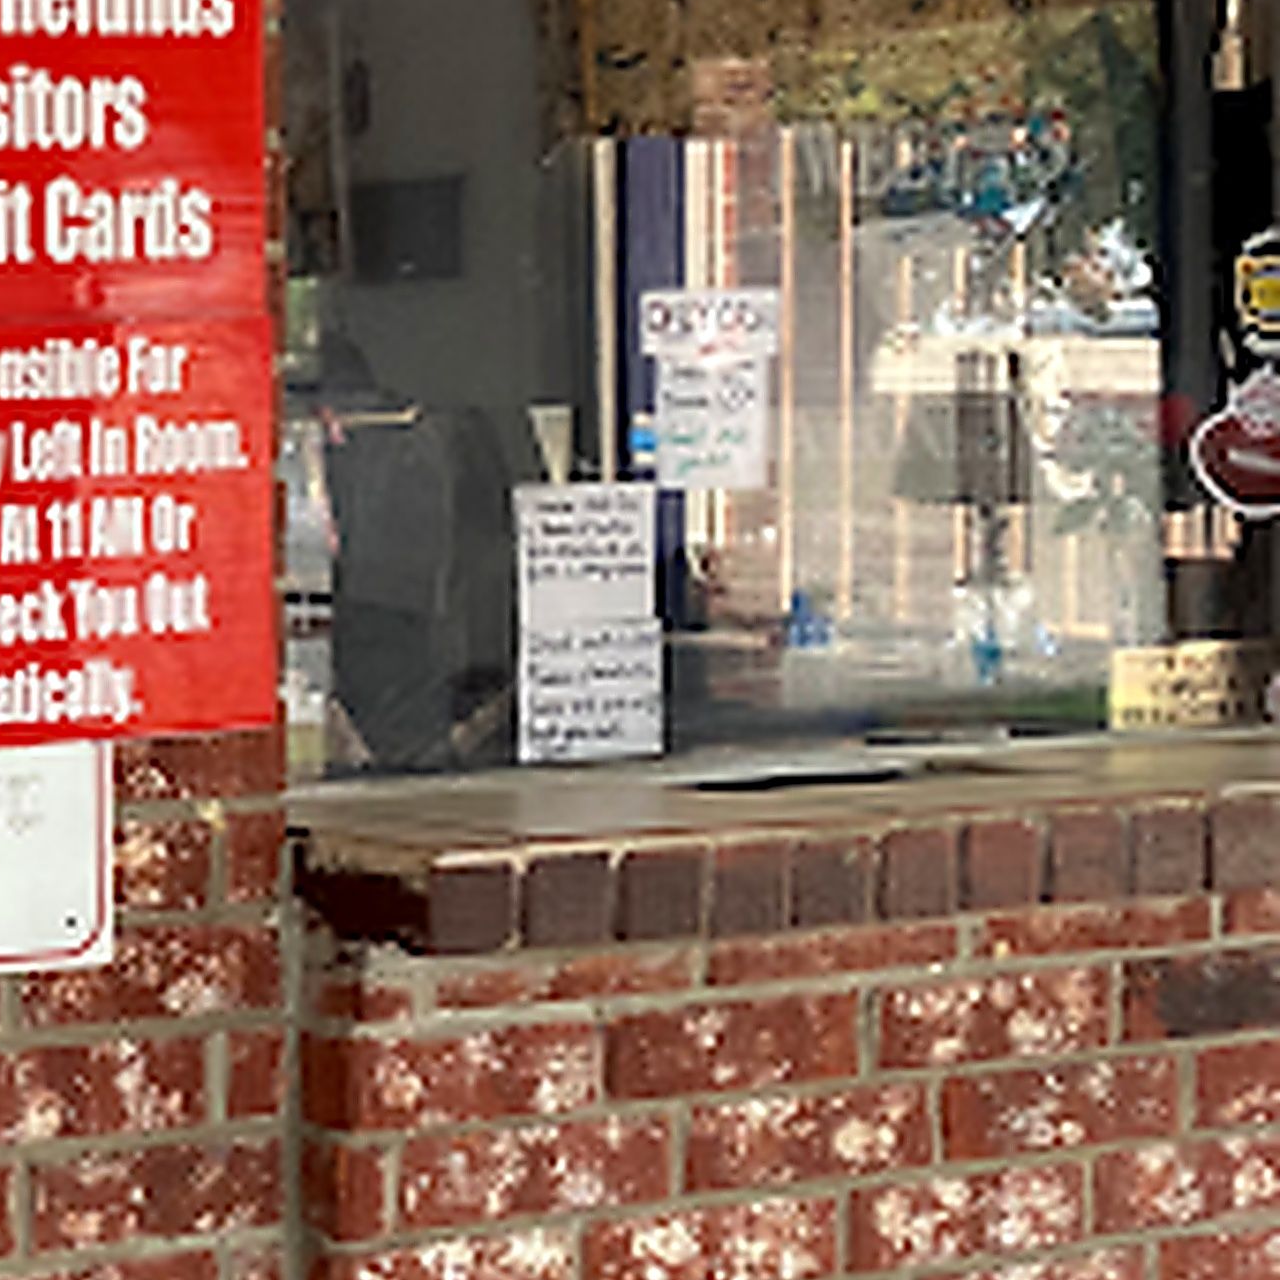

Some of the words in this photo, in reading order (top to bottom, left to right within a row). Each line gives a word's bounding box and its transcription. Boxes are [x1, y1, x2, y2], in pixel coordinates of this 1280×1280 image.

[44, 173, 214, 264] Cards
[126, 337, 188, 394] For
[11, 420, 83, 483] Left
[90, 418, 126, 476] In
[134, 415, 248, 473] Room.
[1, 502, 40, 564] At
[45, 500, 83, 560] 11
[91, 496, 143, 557] AM
[151, 493, 196, 553] Or
[69, 579, 137, 639] You
[145, 572, 212, 634] Out
